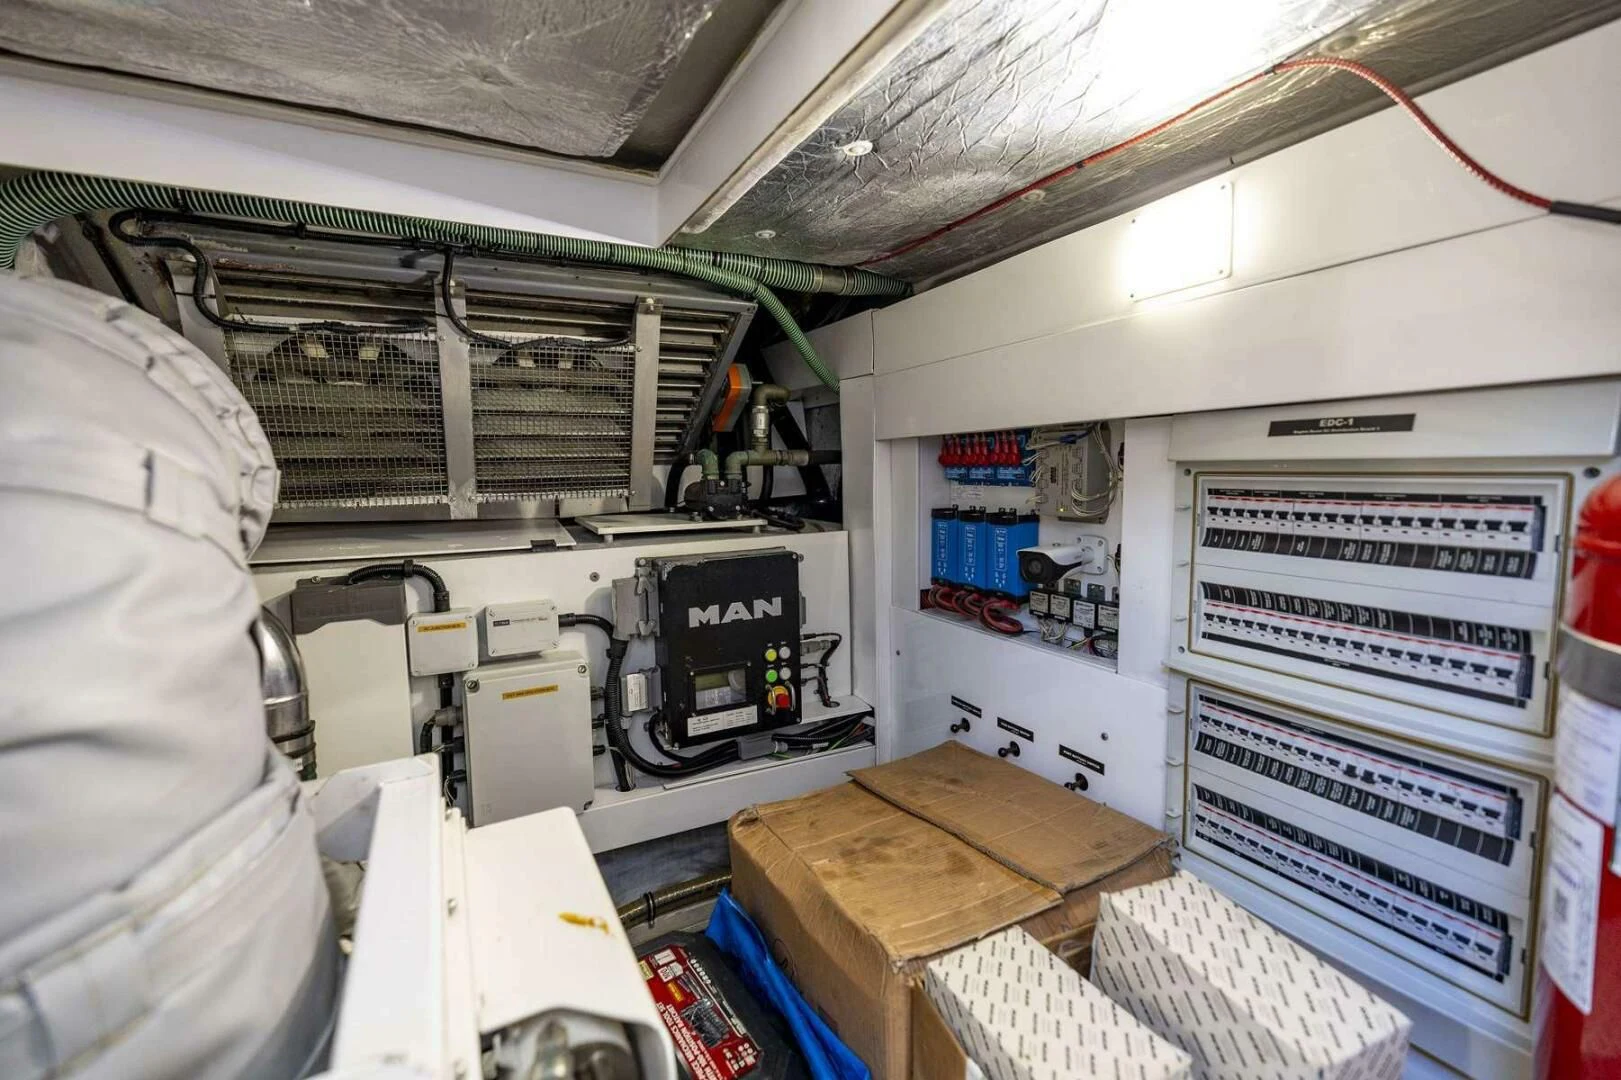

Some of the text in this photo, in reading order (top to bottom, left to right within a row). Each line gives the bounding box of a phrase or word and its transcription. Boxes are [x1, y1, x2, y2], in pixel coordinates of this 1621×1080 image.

[1319, 417, 1354, 427] EDC-1
[688, 597, 782, 628] MAN
[663, 1011, 674, 1027] TOOL
[666, 1004, 685, 1028] RATCHET
[671, 1025, 695, 1062] MECHANICS
